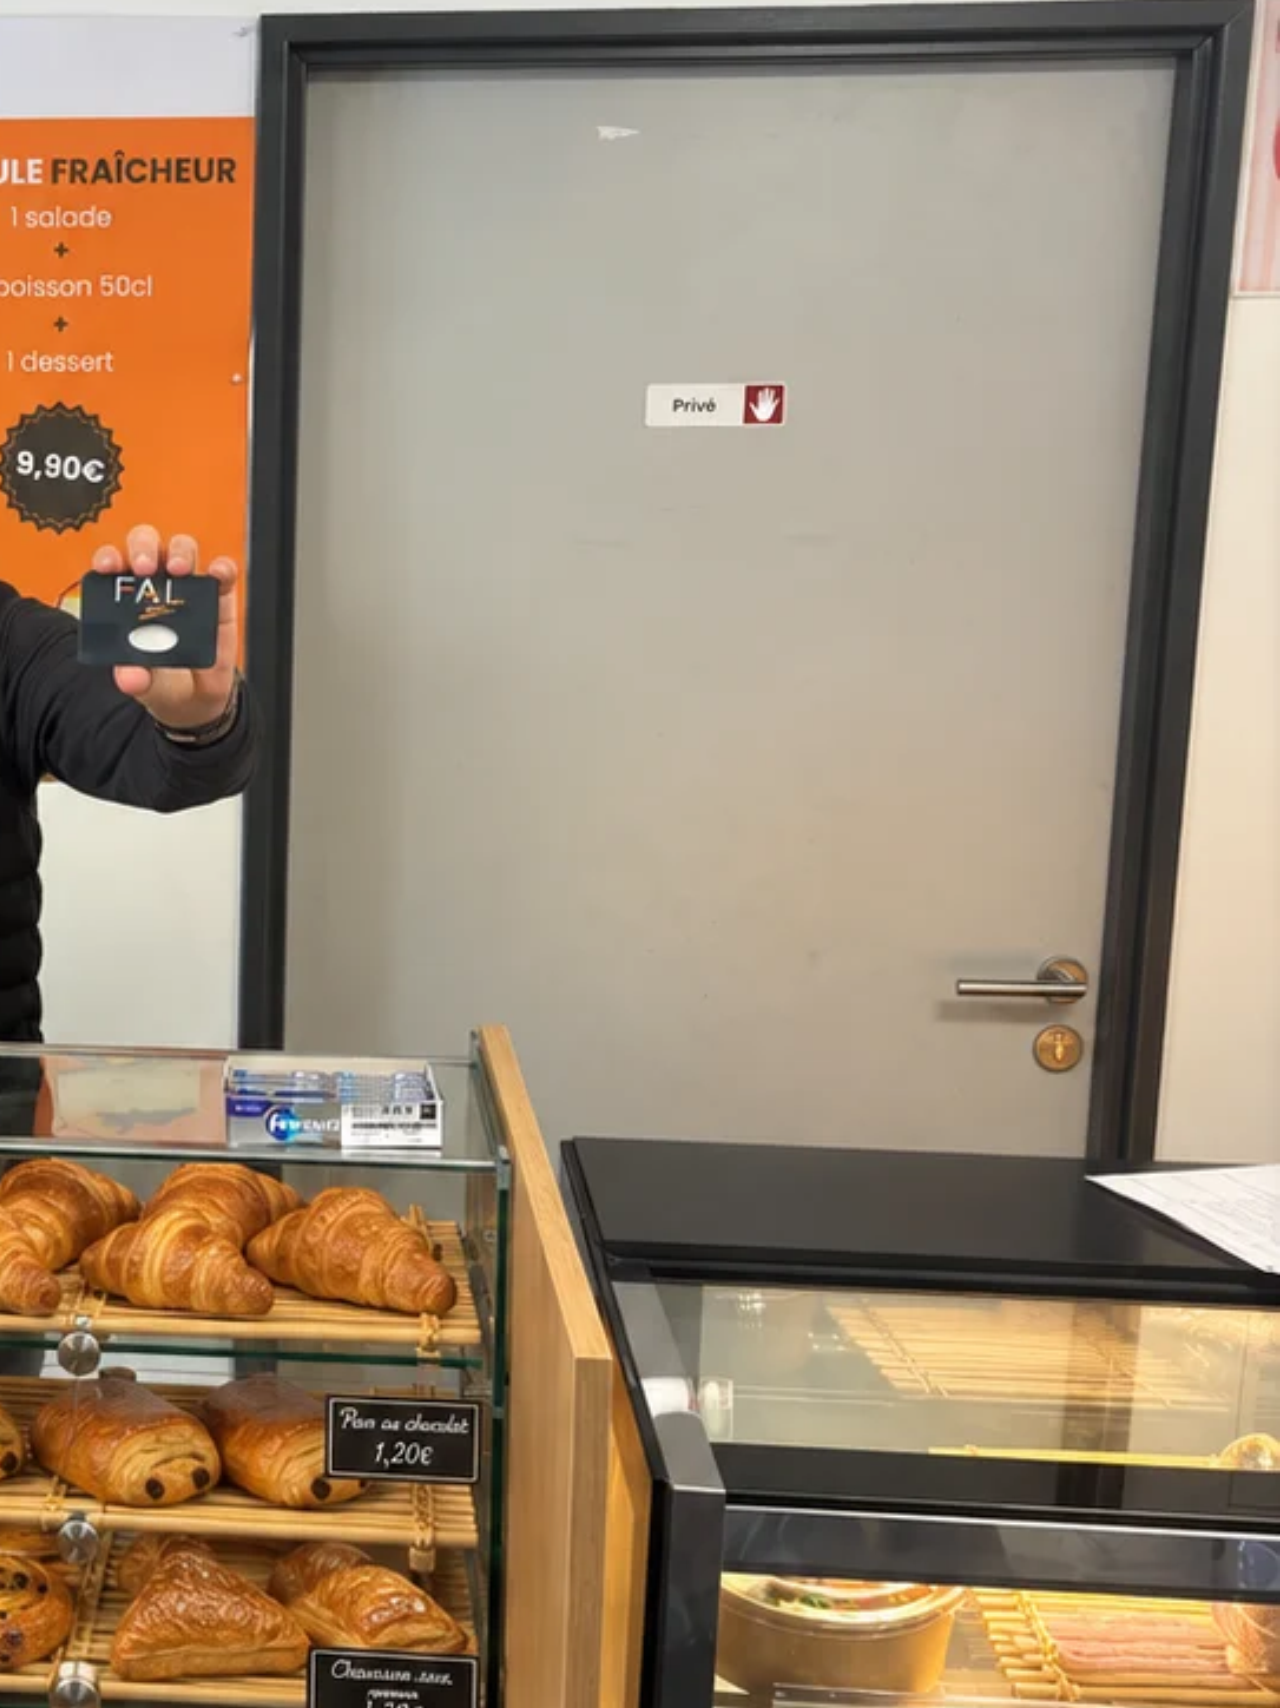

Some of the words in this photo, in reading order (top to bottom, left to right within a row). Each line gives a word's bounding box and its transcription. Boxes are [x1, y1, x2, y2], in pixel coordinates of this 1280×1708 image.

[51, 149, 237, 185] FRAÎCHEUR
[10, 206, 18, 228] 1
[24, 206, 112, 228] salade
[99, 274, 154, 297] 50cl
[6, 350, 14, 372] 1
[20, 350, 114, 373] dessert
[672, 397, 717, 413] Privé
[15, 450, 106, 484] 9,90€
[115, 576, 184, 605] FAL
[375, 1440, 434, 1469] 1,20€
